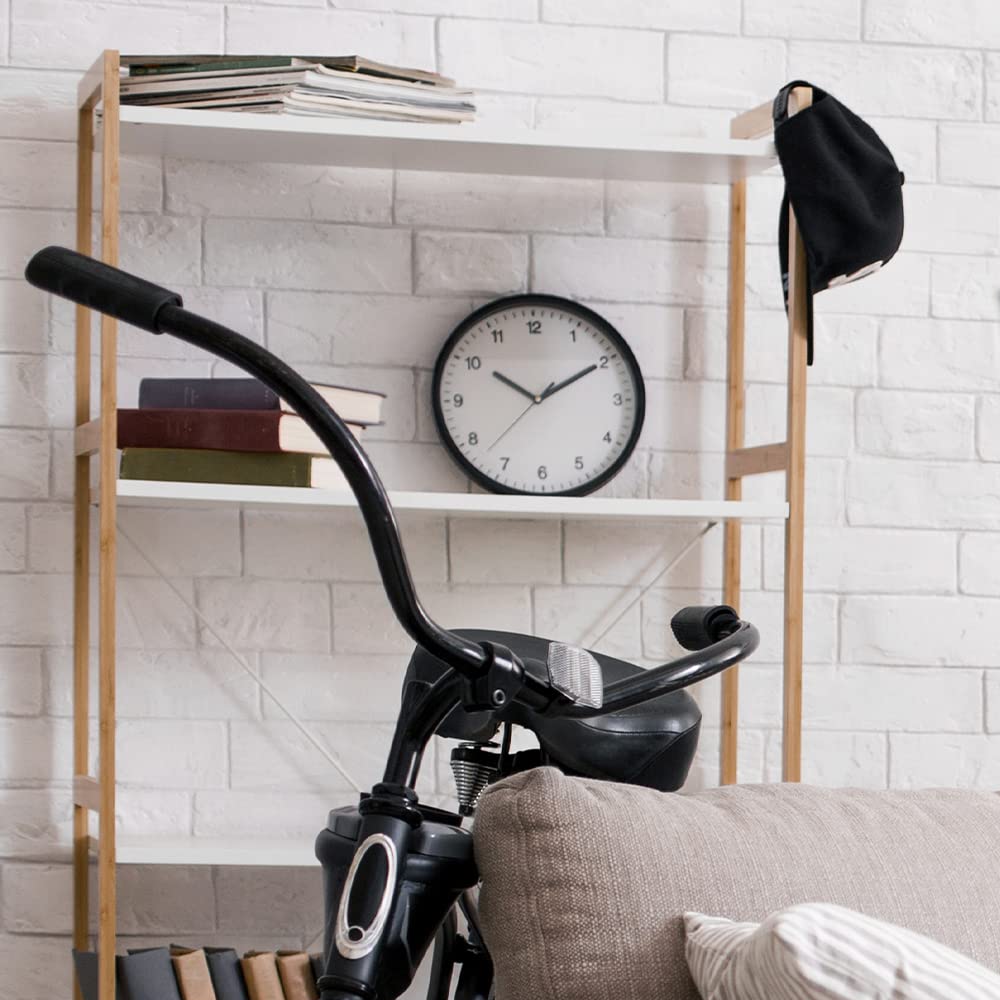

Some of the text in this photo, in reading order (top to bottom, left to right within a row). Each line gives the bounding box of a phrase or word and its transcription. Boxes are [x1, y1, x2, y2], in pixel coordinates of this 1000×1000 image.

[526, 320, 542, 335] 12
[491, 330, 503, 343] 11
[569, 330, 576, 342] 1
[465, 356, 481, 370] 10
[599, 356, 609, 369] 2
[453, 394, 463, 407] 9
[613, 393, 623, 406] 3
[468, 432, 478, 445] 8
[602, 431, 612, 444] 4
[500, 457, 510, 471] 7
[574, 456, 584, 470] 5
[537, 466, 547, 480] 6
